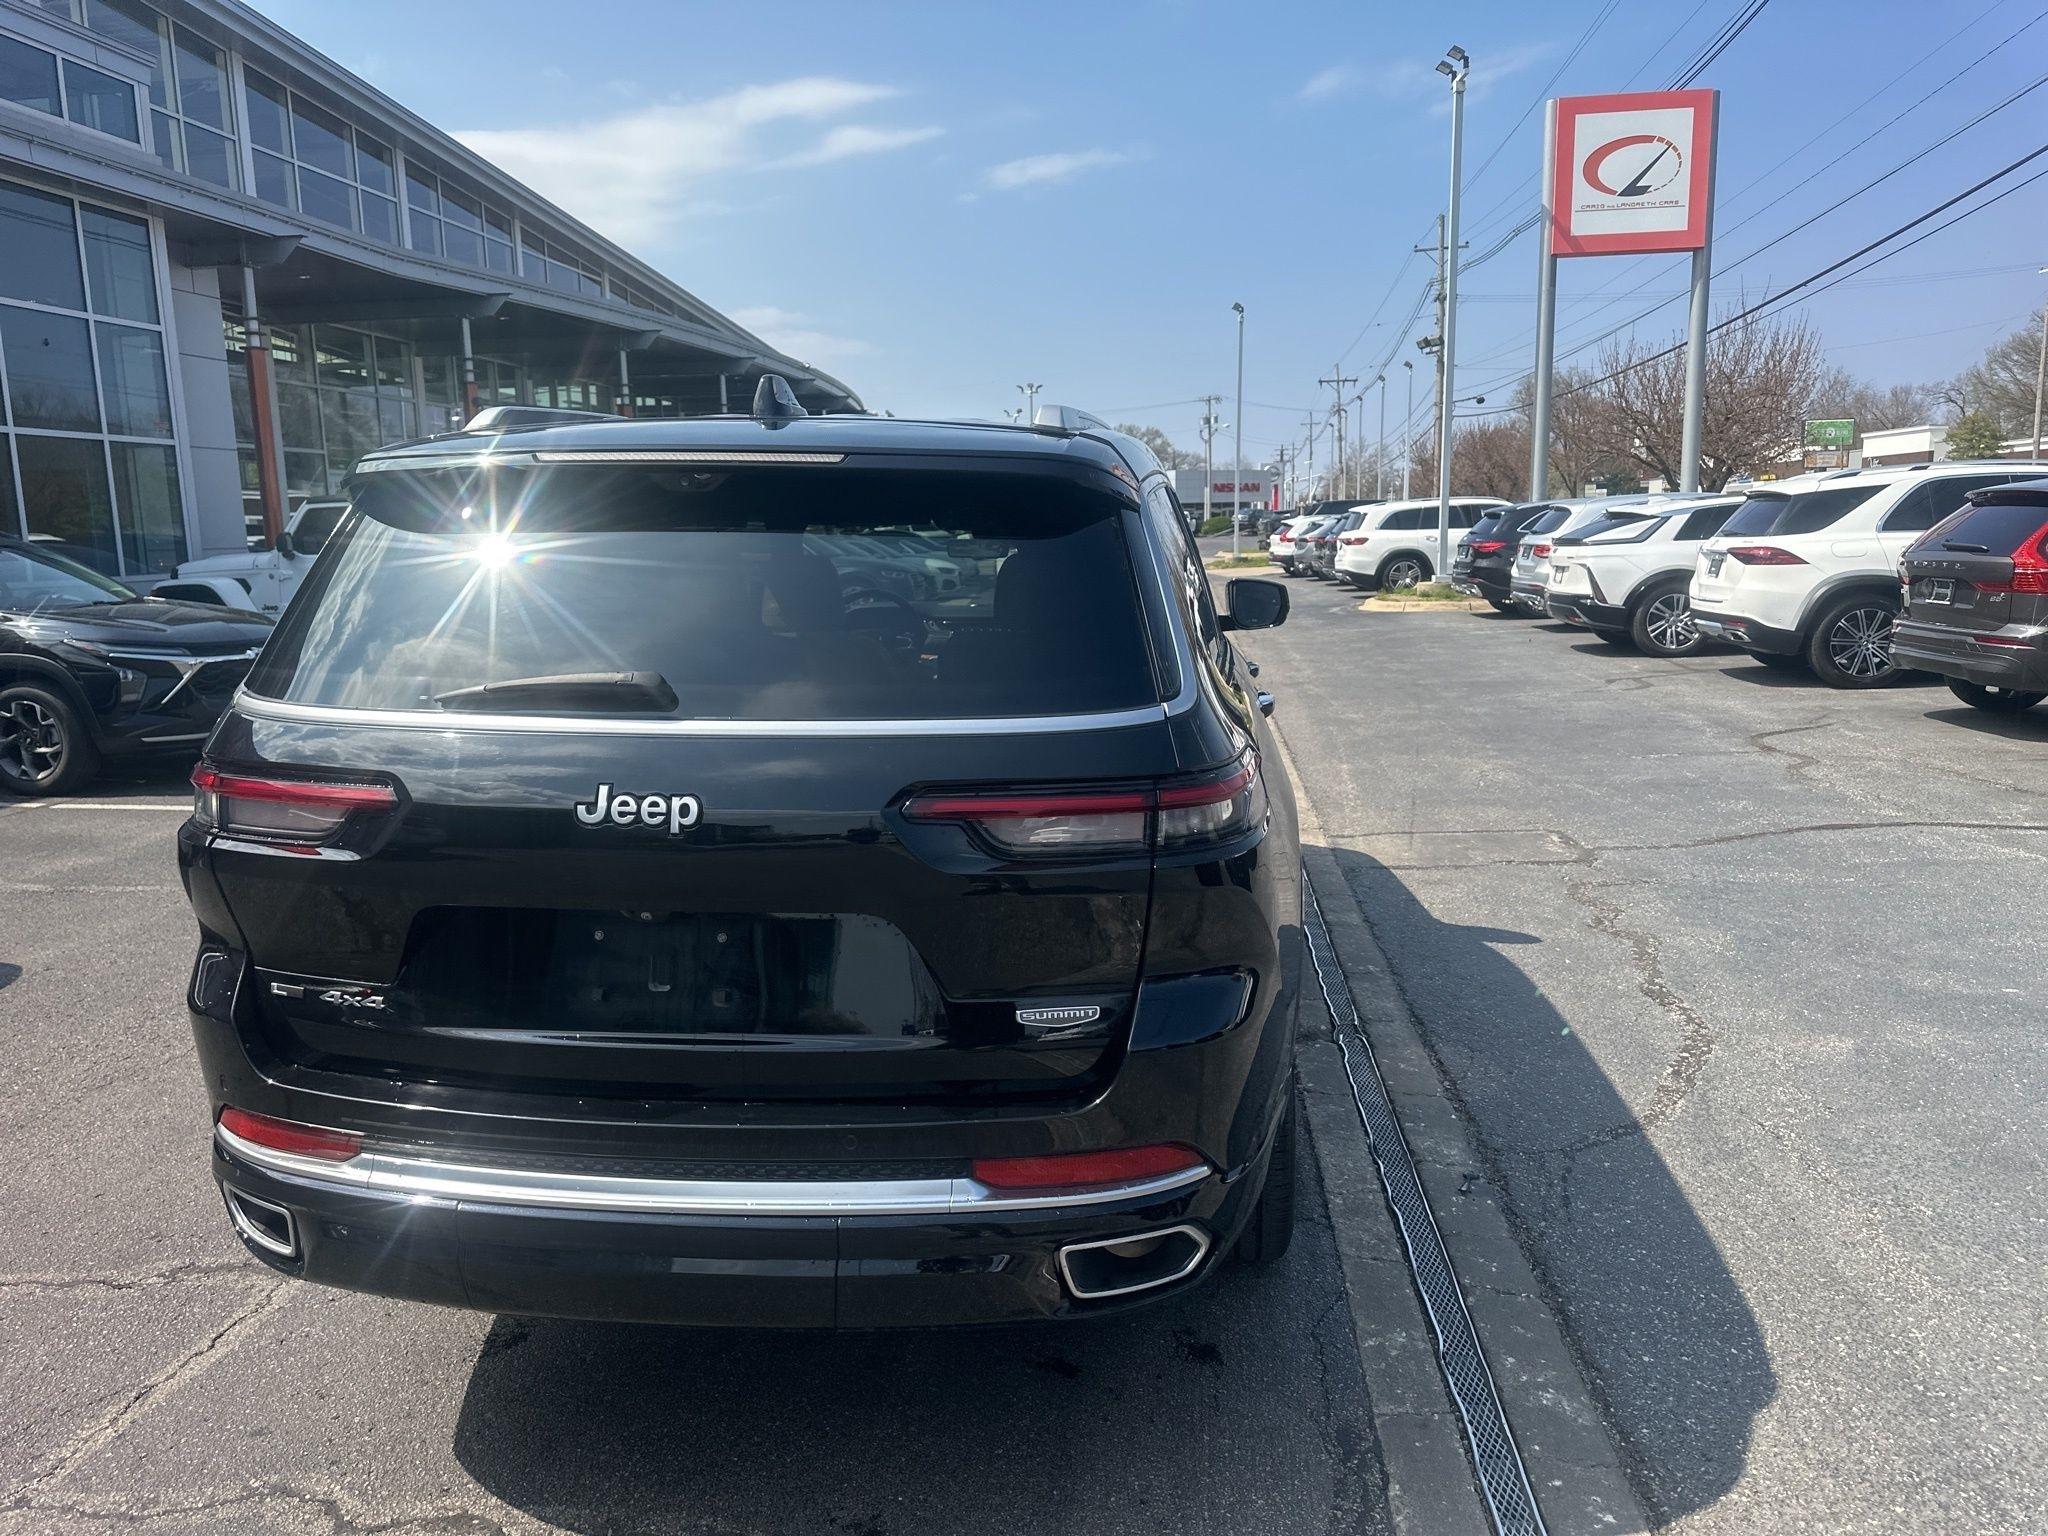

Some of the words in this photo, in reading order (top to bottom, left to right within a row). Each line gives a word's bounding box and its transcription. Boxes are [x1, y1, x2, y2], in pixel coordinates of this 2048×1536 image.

[261, 603, 279, 612] Jeep
[577, 784, 699, 834] Jeep
[318, 990, 387, 1010] 4x4
[1022, 1008, 1097, 1021] SUMMIT
